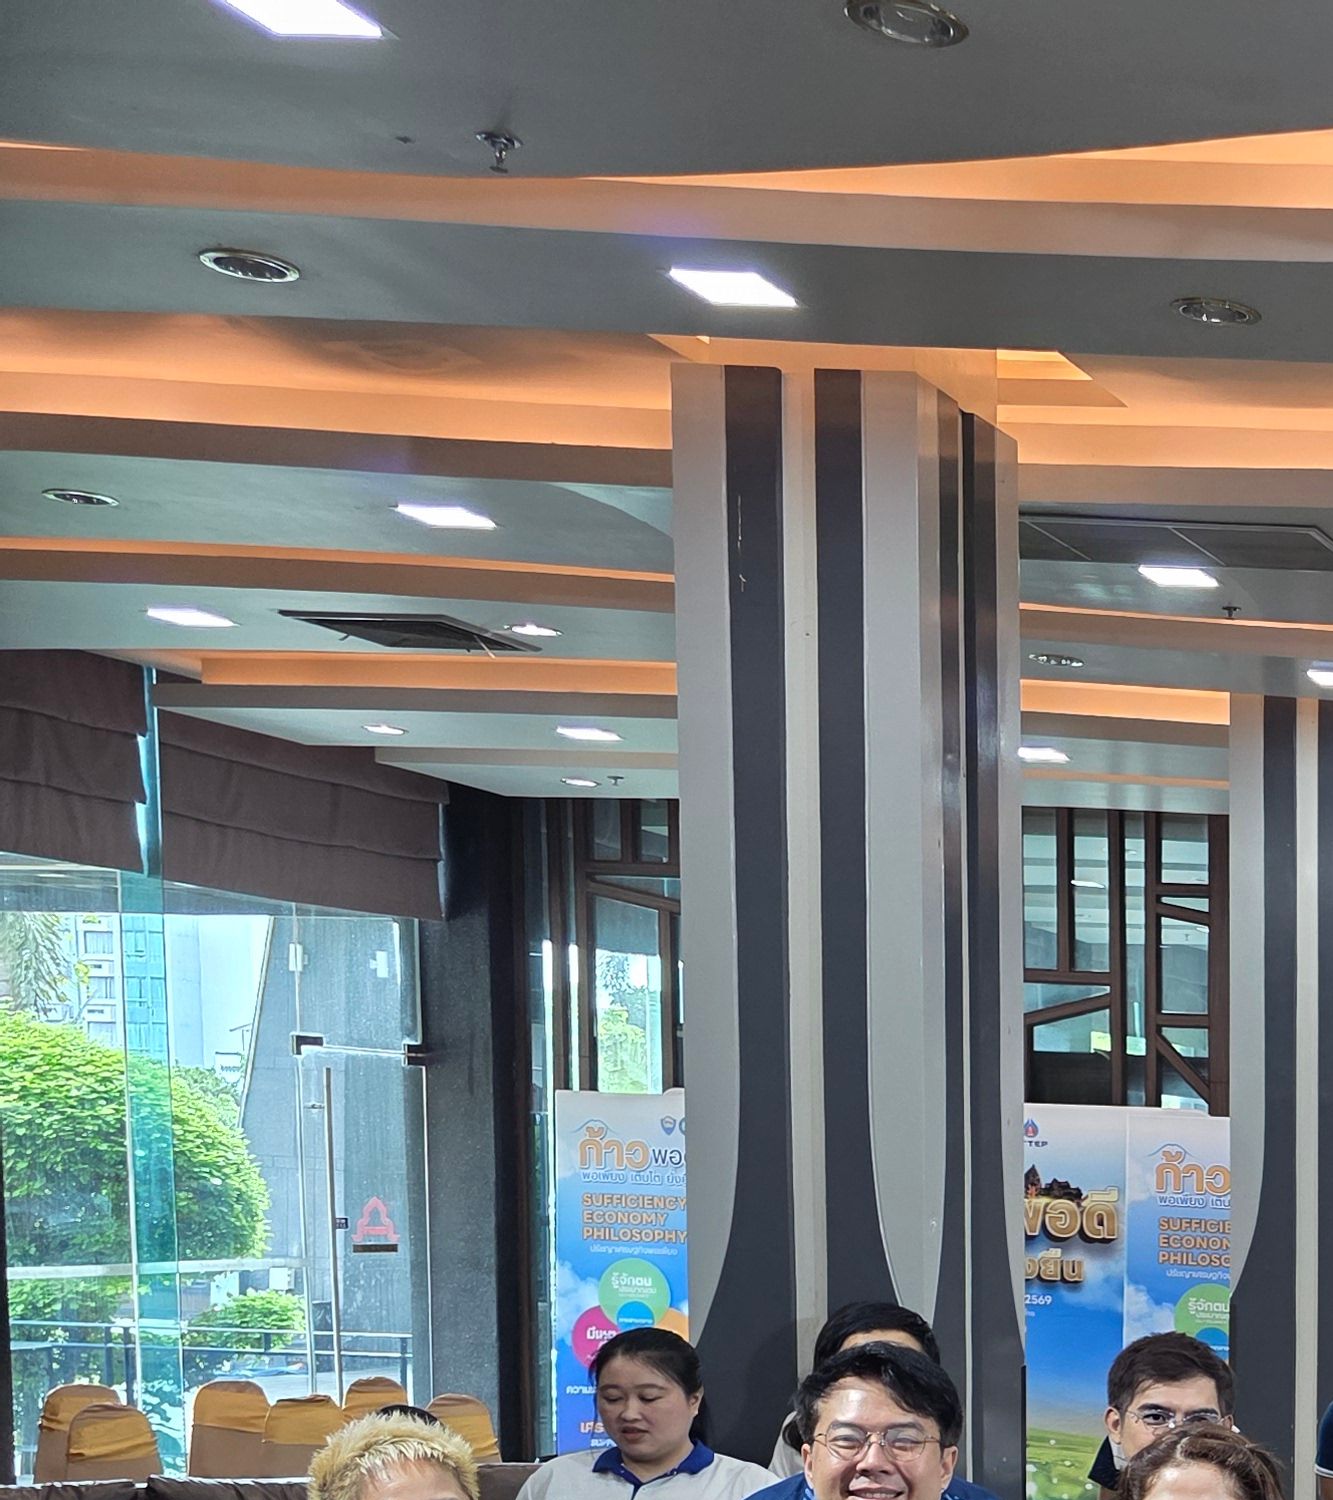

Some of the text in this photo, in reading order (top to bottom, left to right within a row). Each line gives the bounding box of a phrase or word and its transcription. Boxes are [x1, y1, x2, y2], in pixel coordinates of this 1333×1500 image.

[583, 1193, 687, 1210] SUFFICIENCY
[583, 1210, 667, 1225] ECONOMY
[583, 1227, 687, 1243] PHILOSOPHY
[1025, 1294, 1052, 1305] 2569
